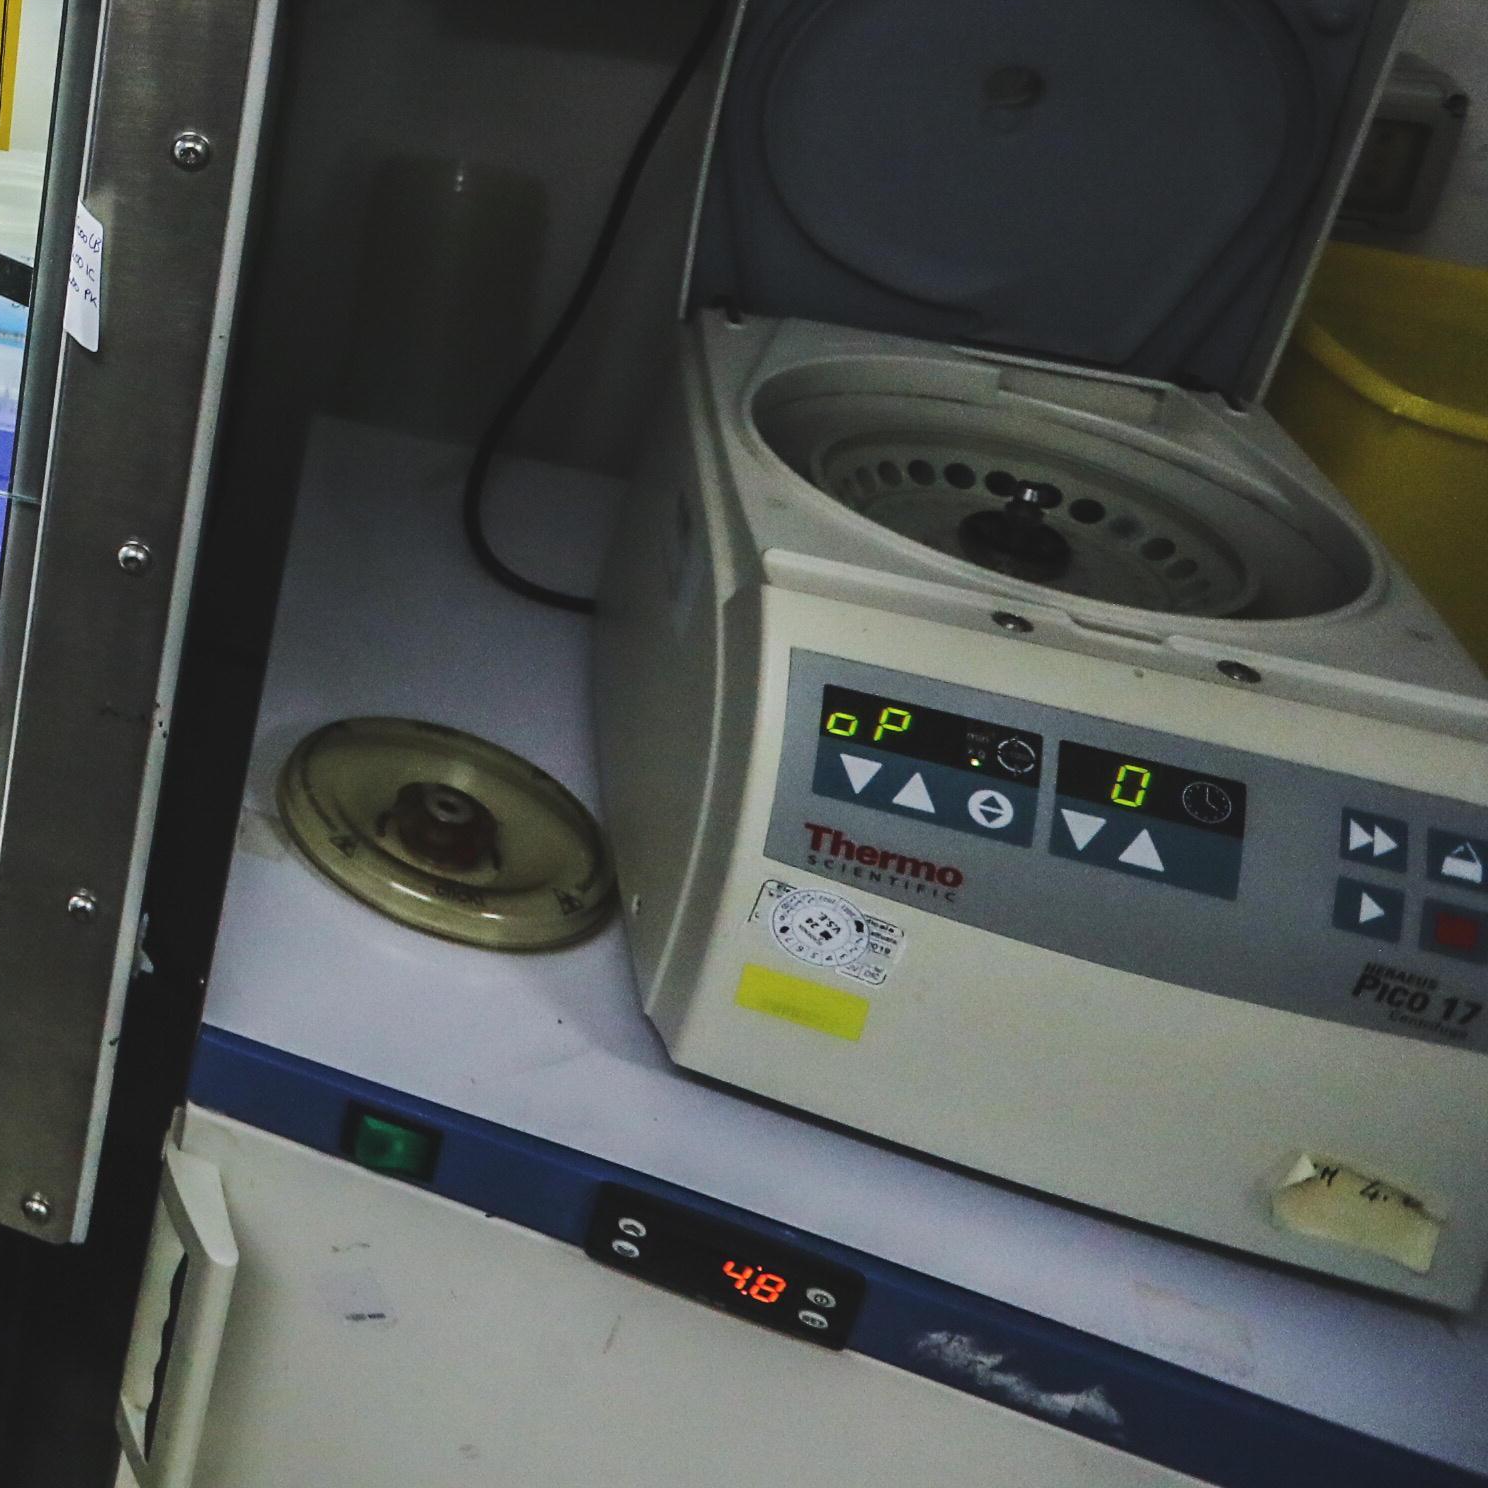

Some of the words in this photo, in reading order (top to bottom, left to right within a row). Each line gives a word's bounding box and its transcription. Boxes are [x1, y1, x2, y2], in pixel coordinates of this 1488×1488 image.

[1113, 765, 1150, 807] 0
[804, 821, 964, 889] Thermo
[808, 855, 957, 903] SCIENTIFIC
[1442, 997, 1484, 1025] 17
